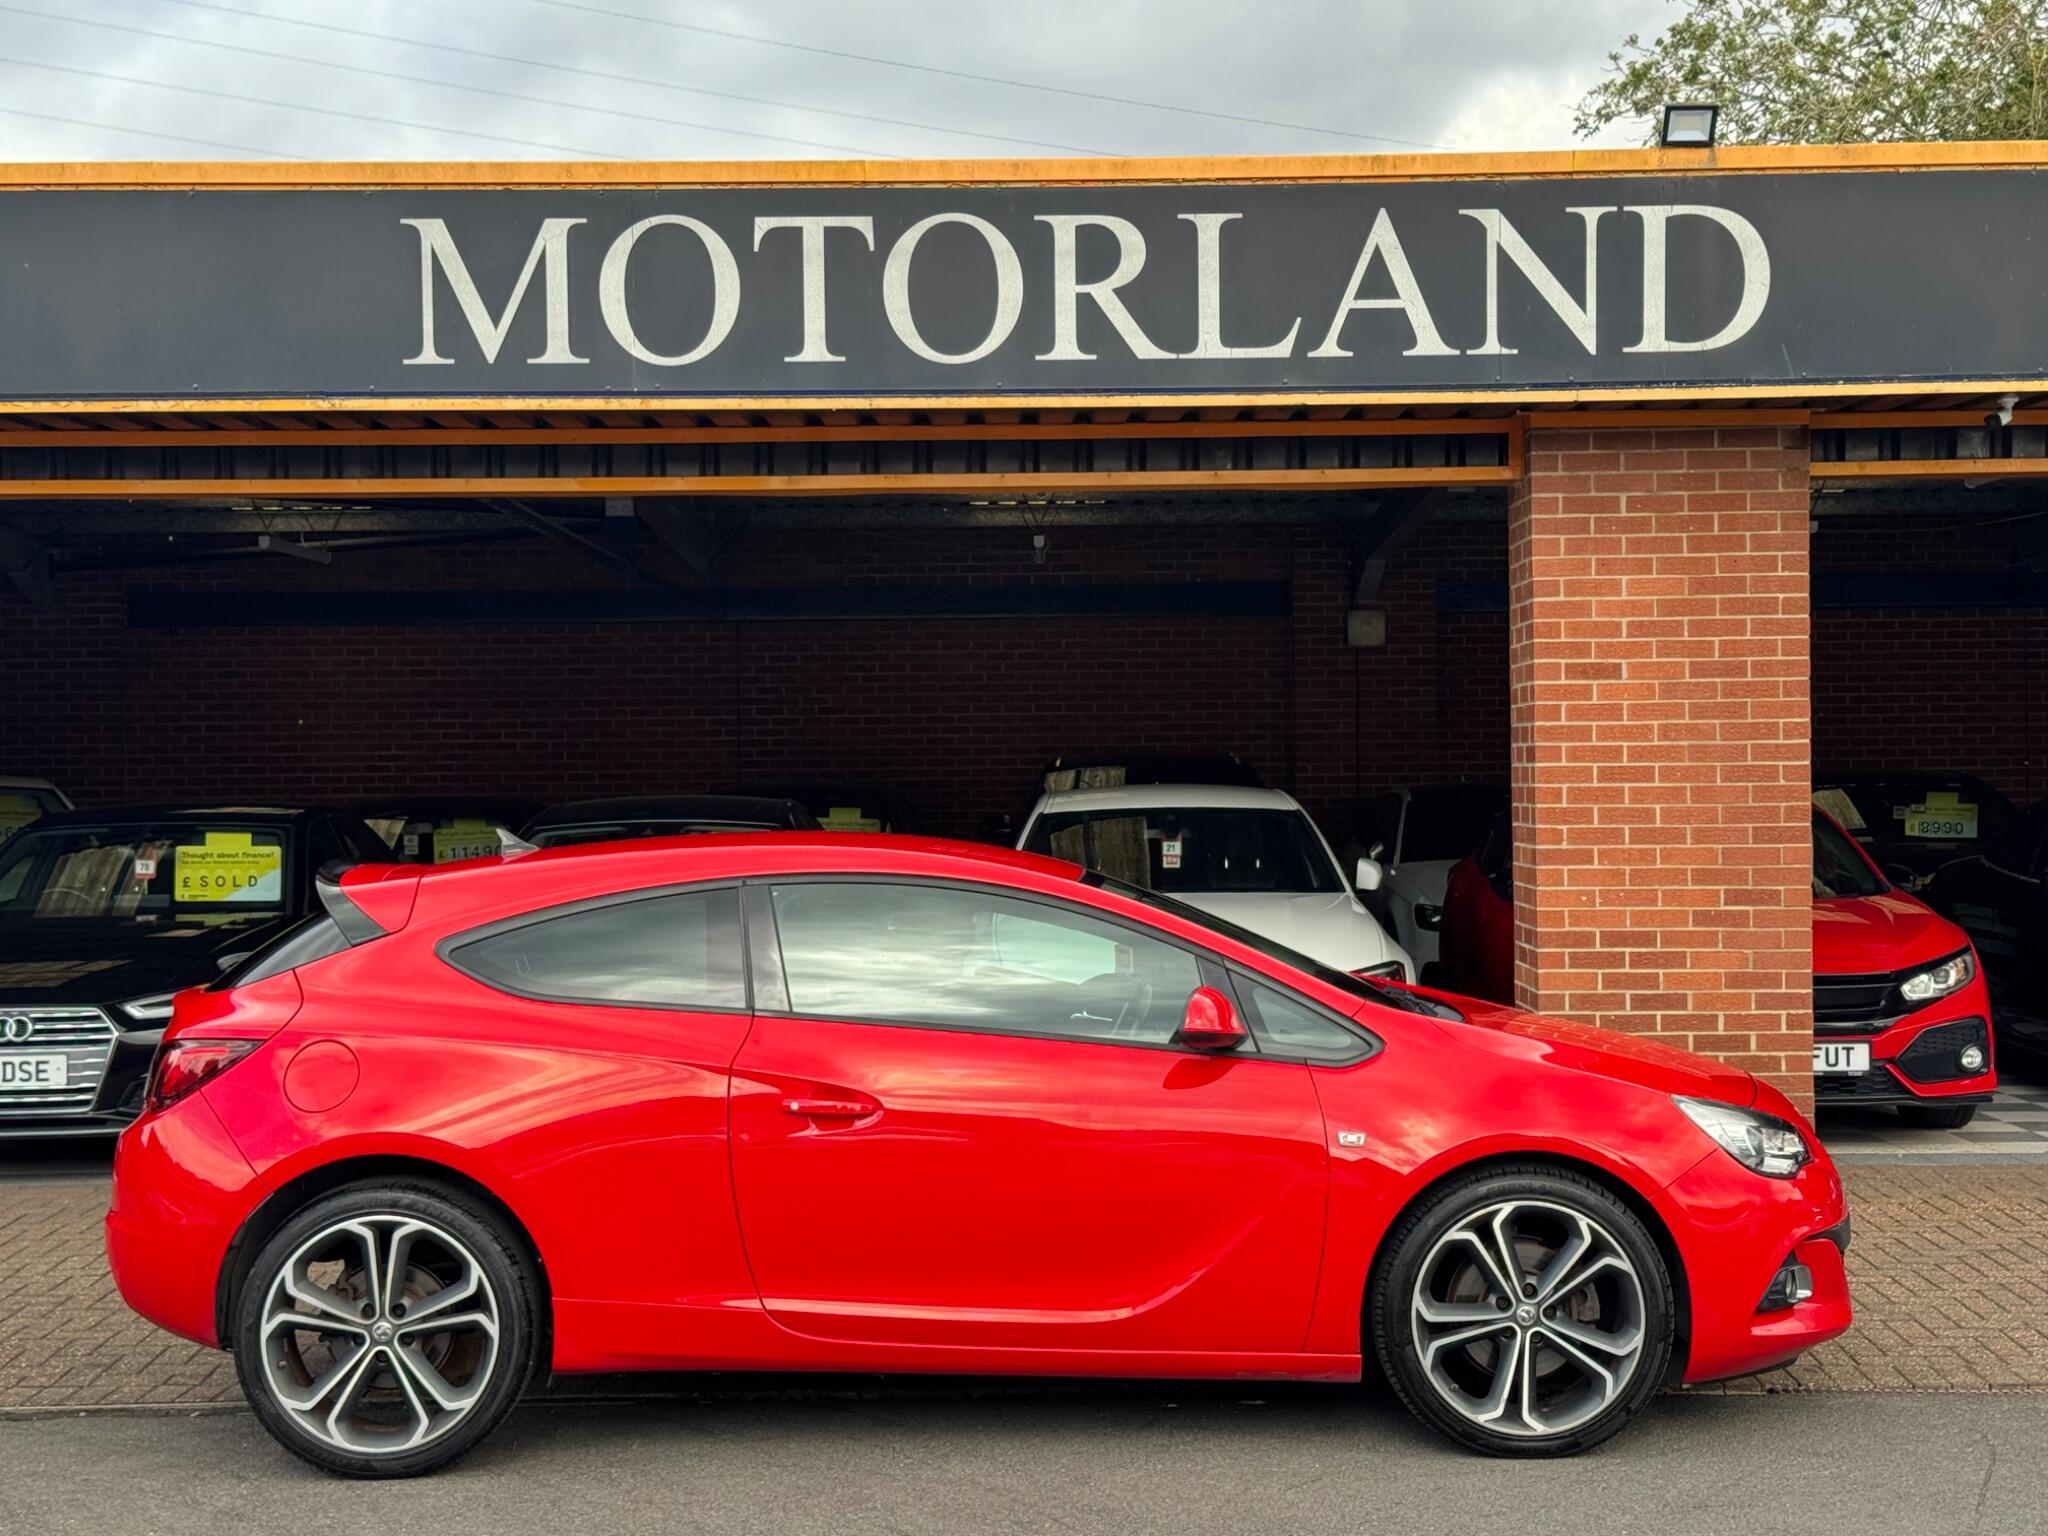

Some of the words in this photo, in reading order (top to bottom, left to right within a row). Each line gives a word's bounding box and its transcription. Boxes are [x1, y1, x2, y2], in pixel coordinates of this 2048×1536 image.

[399, 204, 1772, 367] MOTORLAND
[1166, 844, 1175, 852] 21
[181, 852, 214, 860] Thought
[242, 851, 274, 859] finance?
[182, 876, 191, 888] £
[199, 875, 258, 888] SOLD
[2, 1060, 50, 1083] DSE
